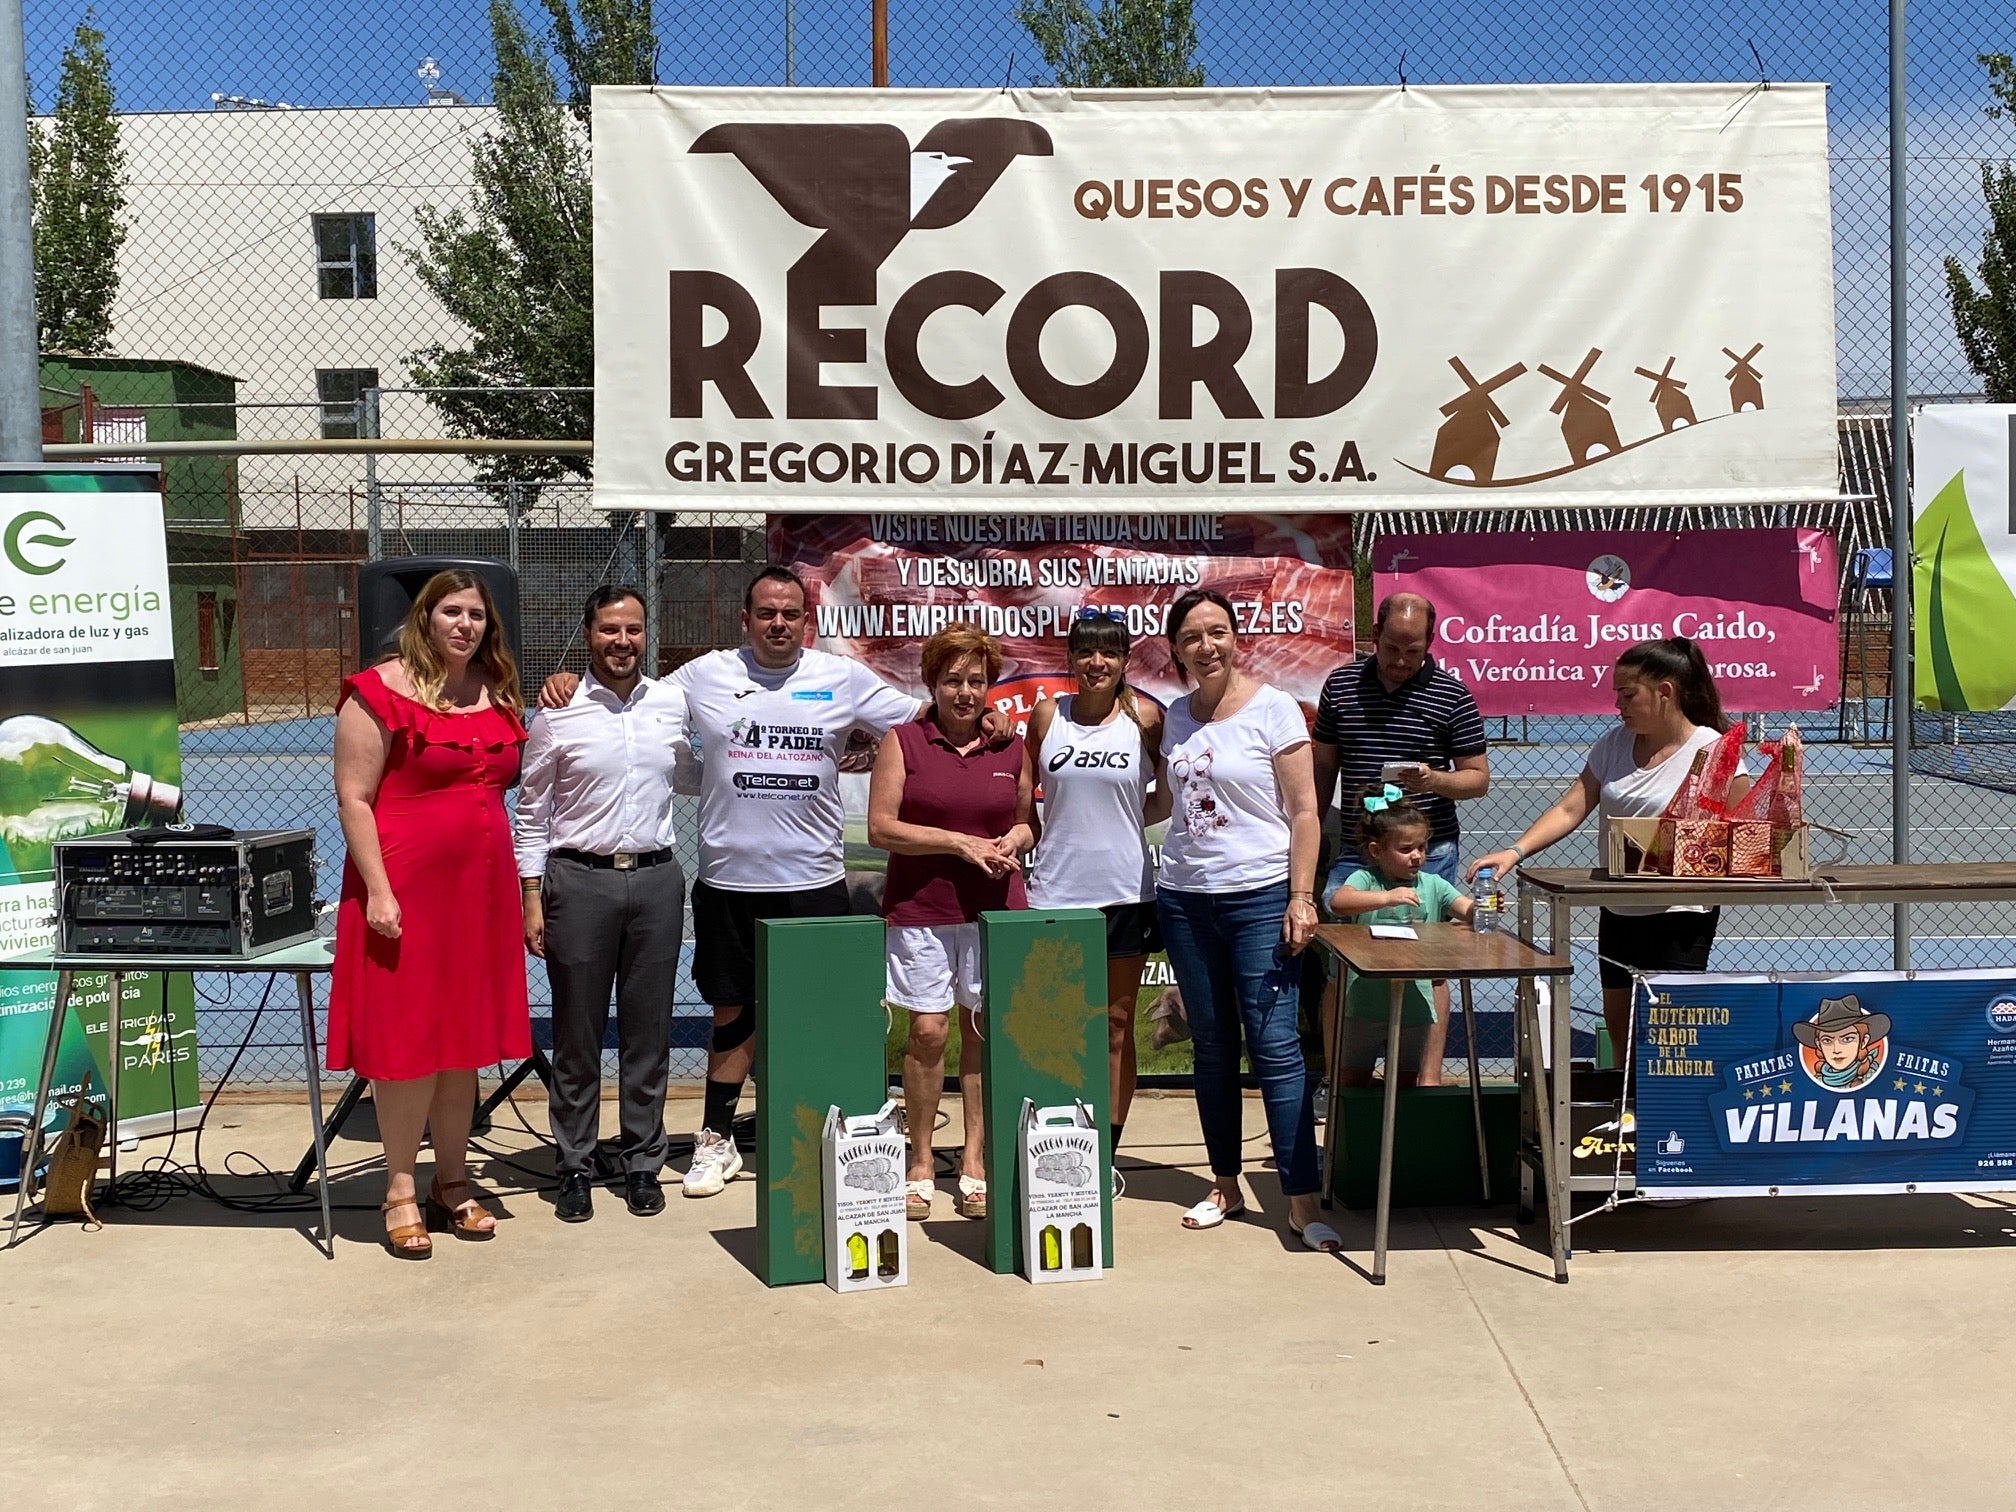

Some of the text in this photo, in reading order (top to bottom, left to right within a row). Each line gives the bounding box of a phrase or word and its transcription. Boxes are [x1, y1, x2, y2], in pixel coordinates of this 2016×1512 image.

[1073, 164, 1745, 221] QUESOS Y CAFÉS DESDE 1915
[669, 267, 1378, 421] RECORD
[665, 440, 940, 484] GREGORIO
[1288, 441, 1378, 482] S.A.
[870, 513, 1224, 543] VISITE NUESTRA TIENDA ON LINE
[896, 556, 1200, 588] Y DESCUBRA SUS VENTAJAS
[28, 584, 161, 621] energía
[69, 625, 86, 639] de
[90, 625, 110, 638] luz
[113, 626, 122, 640] y
[125, 626, 150, 640] gas
[1439, 610, 1776, 649] Cofradía Jesus Caido,
[3, 644, 93, 657] alcázar de san juan
[1466, 657, 1586, 683] Verónica
[1591, 665, 1610, 688] y
[768, 724, 810, 736] TORNEO
[811, 727, 824, 736] DE
[767, 735, 825, 751] PADEL
[728, 750, 824, 761] REINA DEL ALTOZANO
[736, 791, 818, 801] www.telconet.info
[66, 993, 84, 1007] de
[1660, 992, 1672, 1005] EL
[85, 1012, 176, 1035] ELETRICIDAD
[1648, 1004, 1730, 1026] AUTÉNTICO
[1647, 1026, 1699, 1046] SABOR
[124, 1046, 190, 1071] PARES
[1659, 1046, 1687, 1058] DE LA
[1647, 1059, 1715, 1076] LLANURA
[1735, 1053, 1794, 1081] PATATAS
[1896, 1052, 1950, 1077] FRITAS
[6, 1077, 27, 1091] 239
